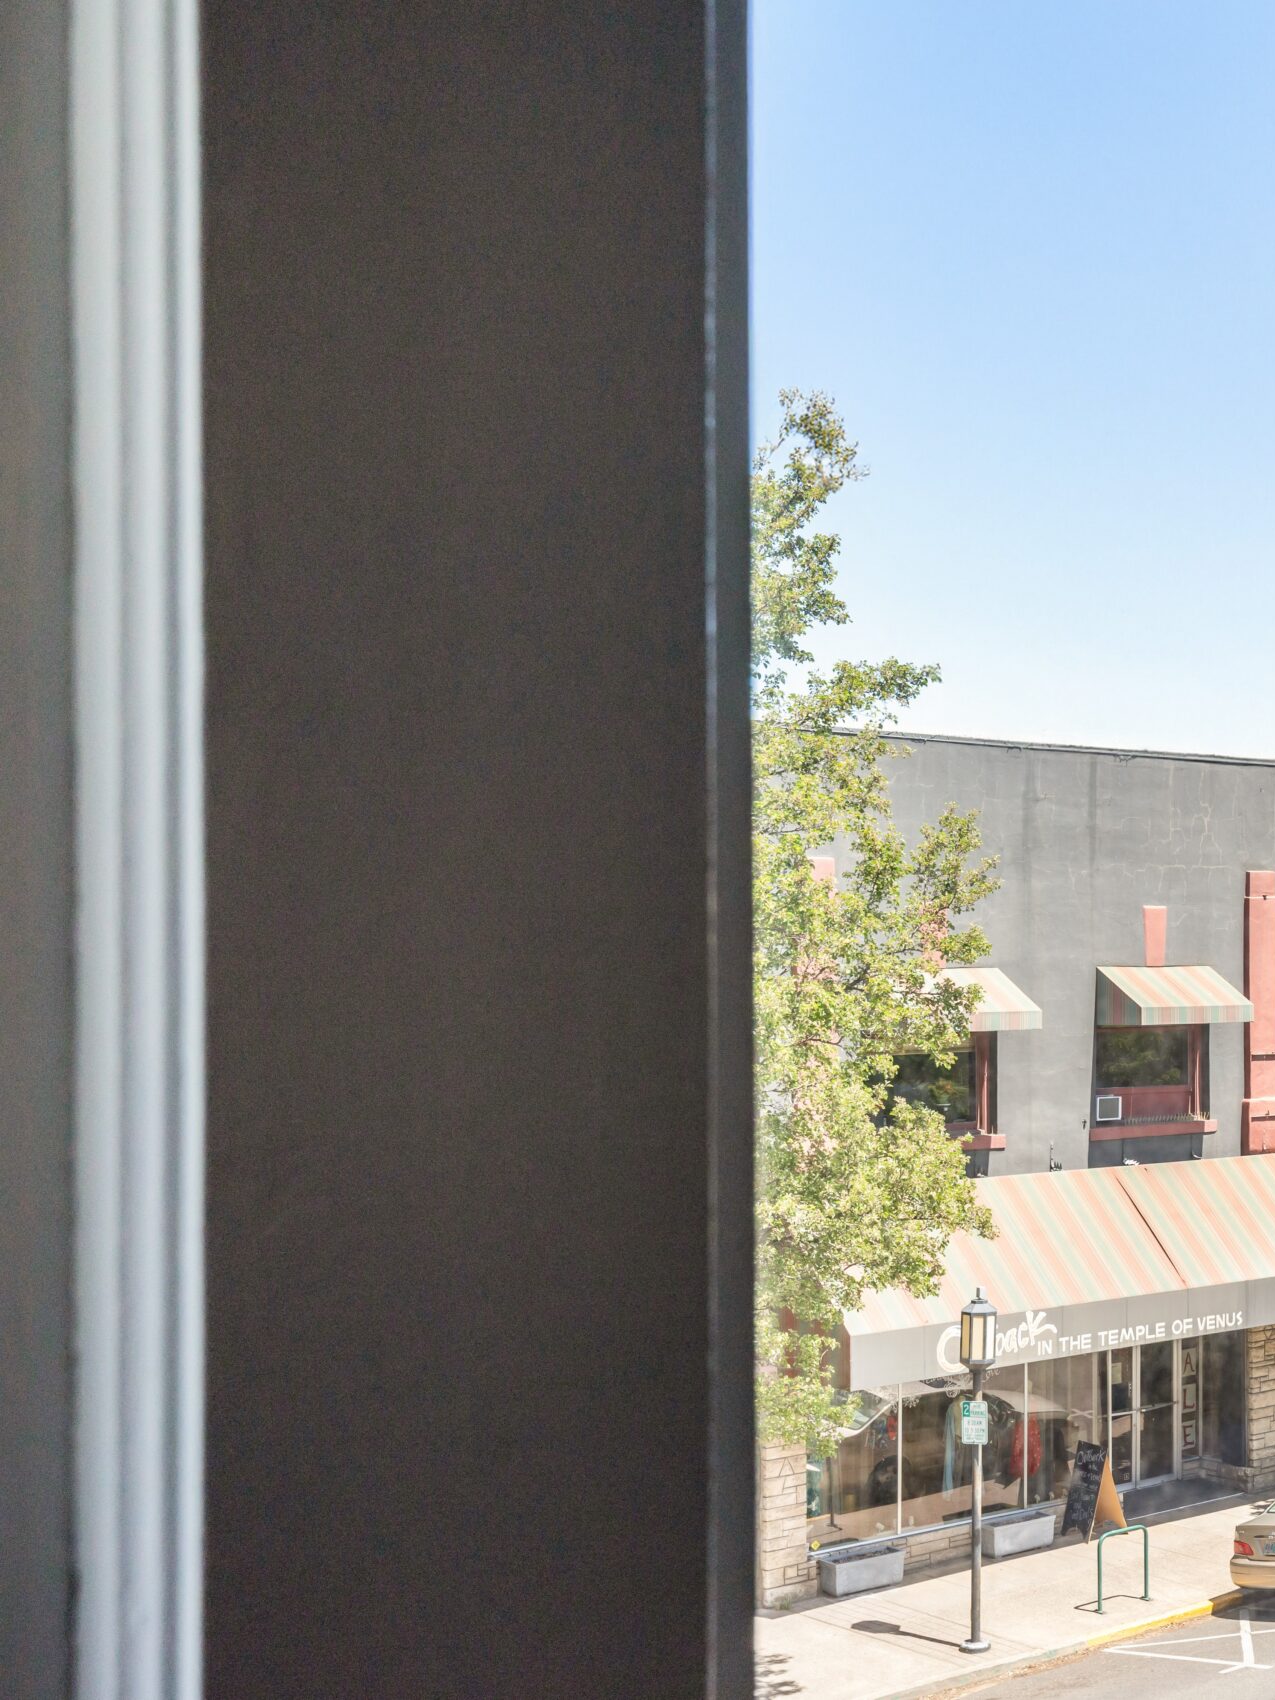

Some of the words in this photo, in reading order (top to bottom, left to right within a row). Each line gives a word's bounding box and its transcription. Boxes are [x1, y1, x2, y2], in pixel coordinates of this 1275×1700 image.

[1037, 1339, 1053, 1356] IN
[1058, 1333, 1092, 1353] THE
[1097, 1321, 1166, 1347] TEMPLE
[1171, 1317, 1193, 1335] OF
[1197, 1310, 1244, 1331] VENUS
[963, 1404, 970, 1415] 2
